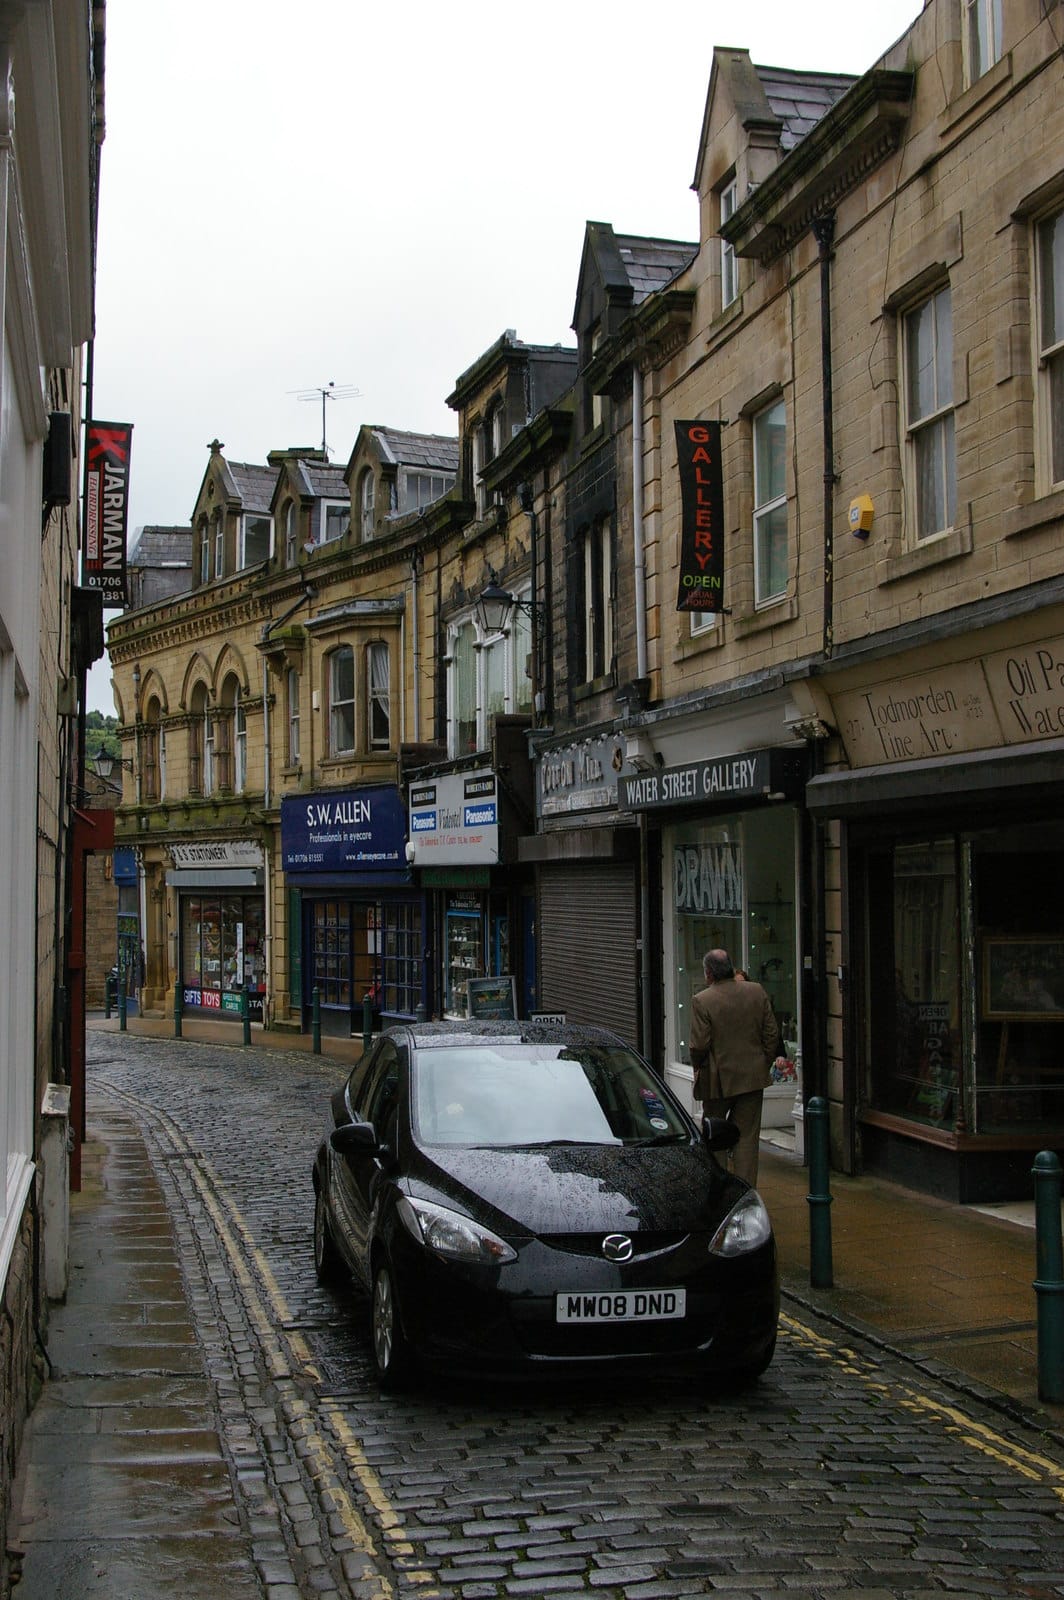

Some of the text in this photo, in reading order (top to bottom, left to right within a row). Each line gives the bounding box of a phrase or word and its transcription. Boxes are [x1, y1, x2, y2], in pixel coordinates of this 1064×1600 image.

[687, 426, 713, 570] GALLERY
[88, 477, 97, 555] HAIRDRESSING
[102, 462, 125, 569] JARMAN
[89, 576, 121, 586] 01706
[682, 574, 721, 588] OPEN
[1006, 658, 1037, 696] Oil
[862, 685, 958, 726] Todmorden
[878, 727, 914, 759] Fine
[626, 777, 658, 805] WATER
[662, 769, 698, 800] STREET
[703, 758, 757, 793] GALLERY
[334, 800, 371, 824] ALLEN
[413, 813, 435, 830] Panasonic
[466, 806, 494, 824] Panasonic
[310, 831, 372, 843] Professionals in eyecare
[190, 847, 228, 860] STATIONERY
[184, 989, 201, 1004] GIFTS
[203, 992, 220, 1007] TOYS
[567, 1293, 676, 1318] MW08 DND
